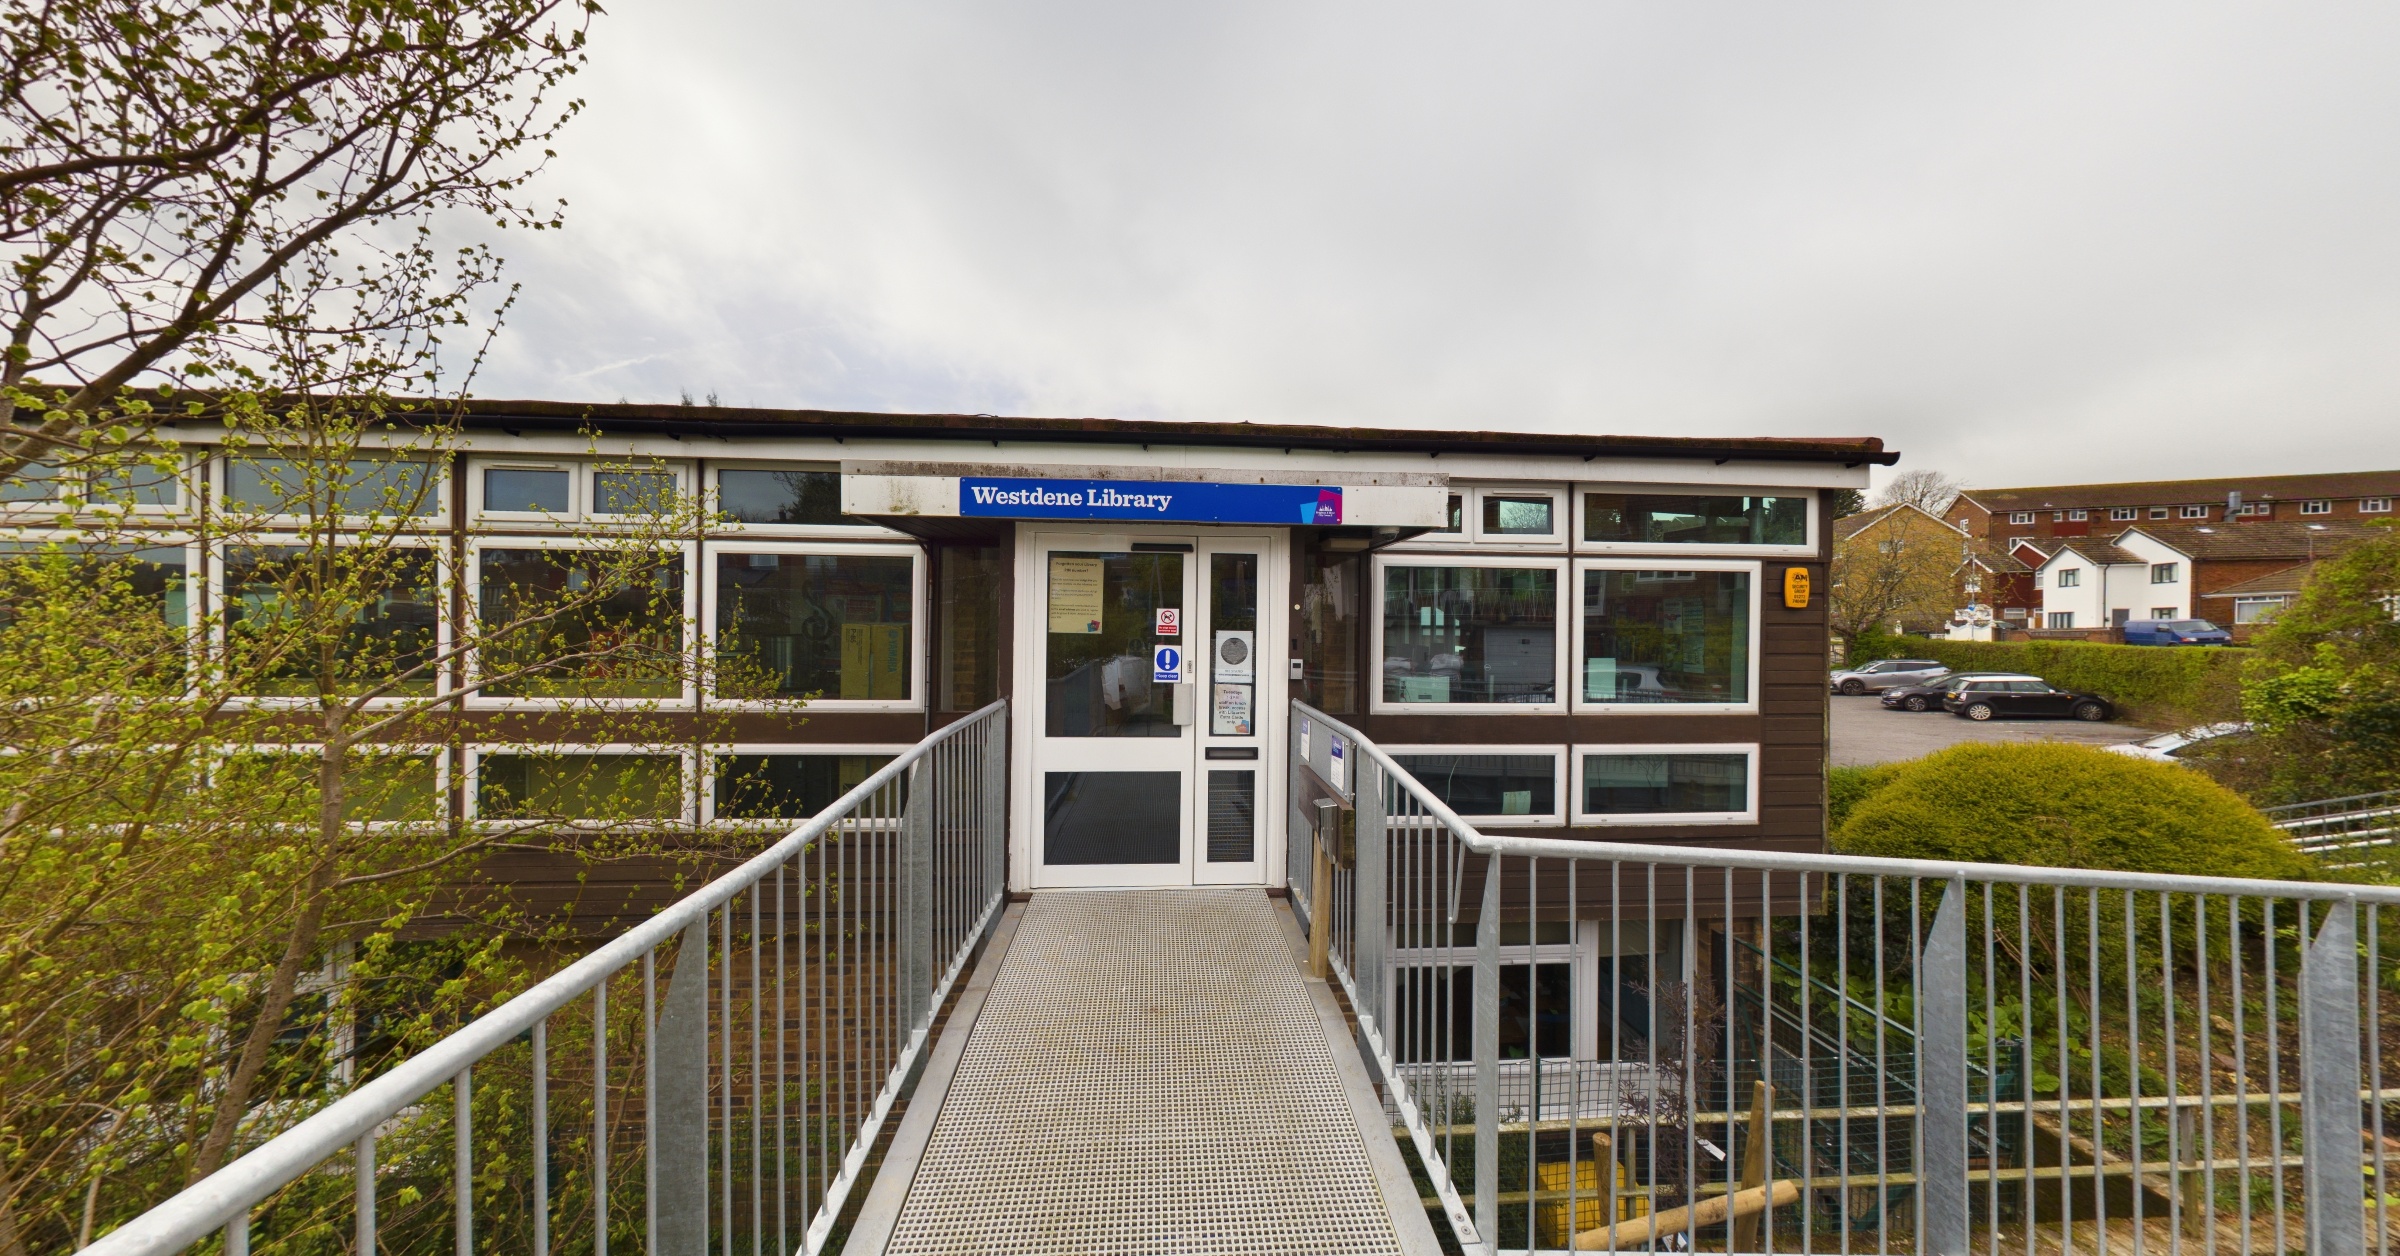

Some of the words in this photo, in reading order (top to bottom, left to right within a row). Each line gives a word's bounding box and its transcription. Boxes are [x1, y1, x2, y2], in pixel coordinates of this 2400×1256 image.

[971, 486, 1082, 506] Westdene
[1086, 489, 1172, 512] Library
[888, 640, 898, 672] YAMAHA
